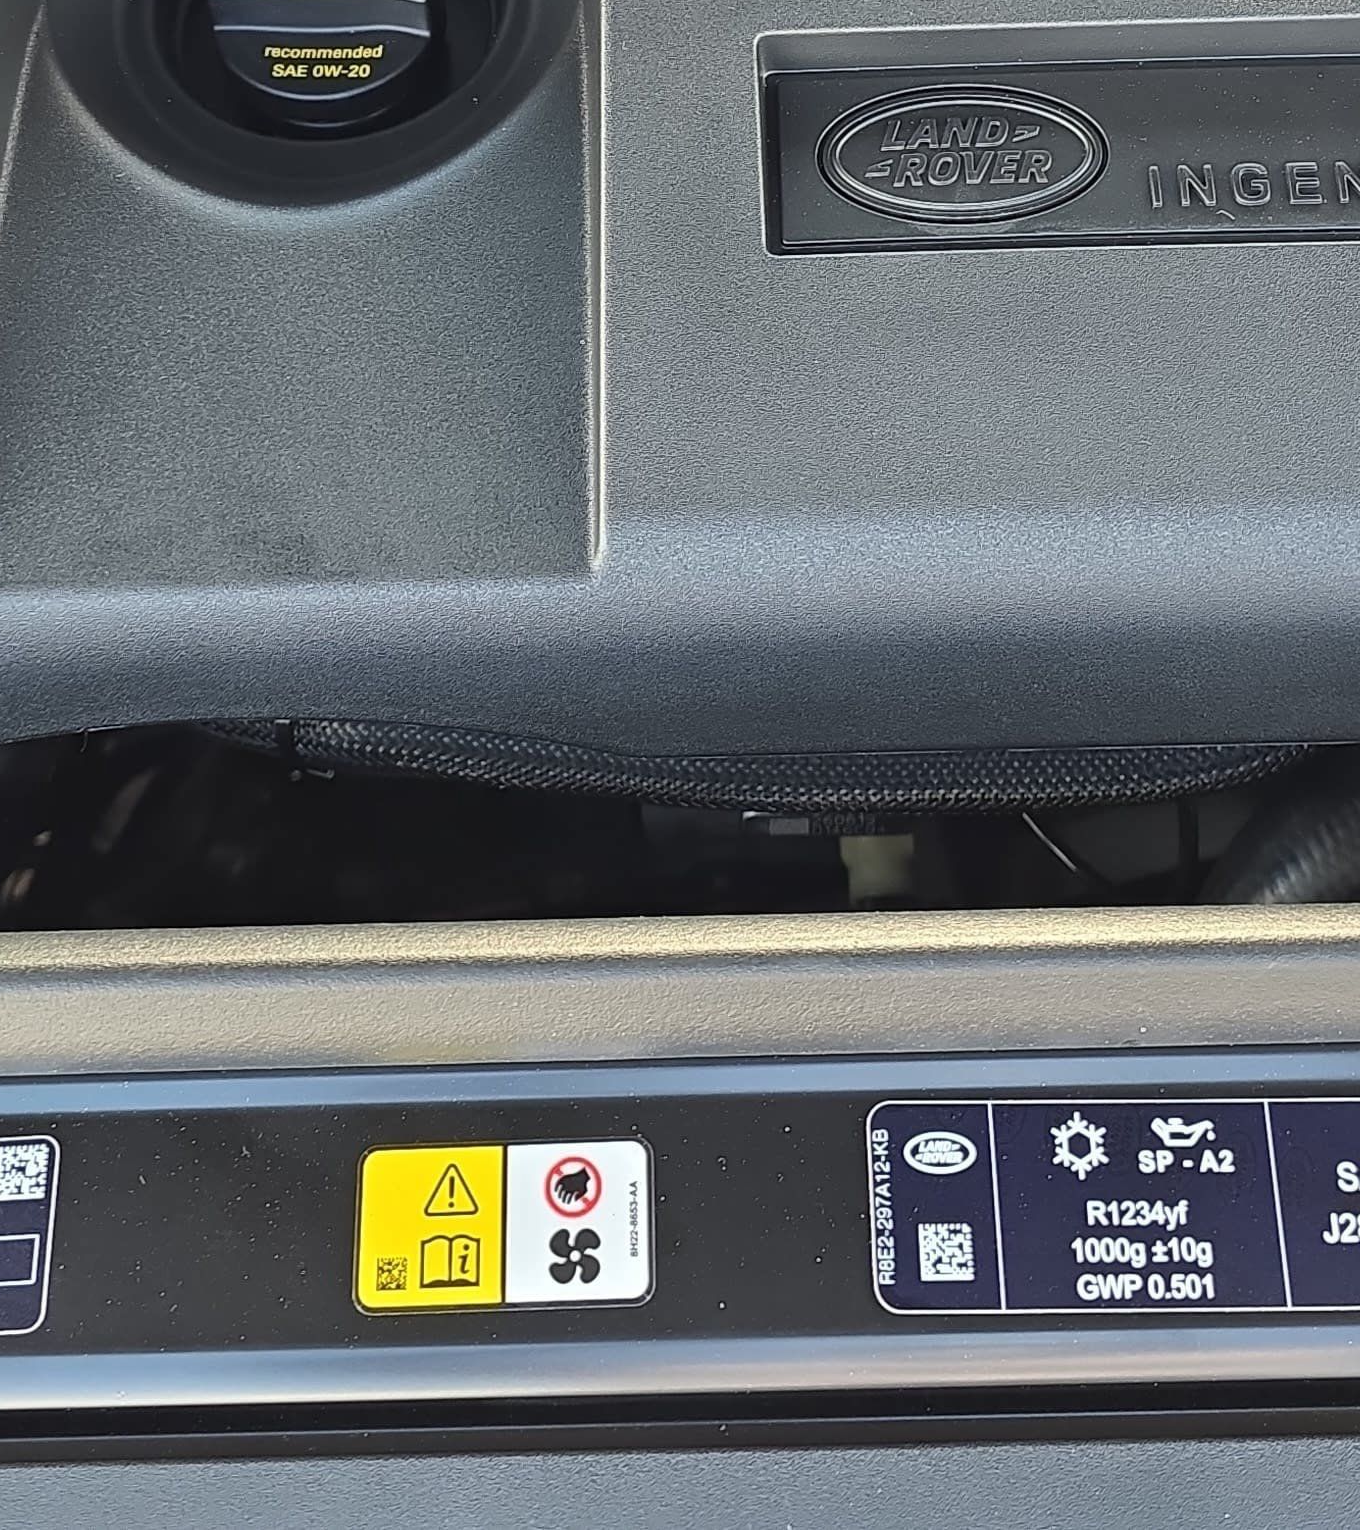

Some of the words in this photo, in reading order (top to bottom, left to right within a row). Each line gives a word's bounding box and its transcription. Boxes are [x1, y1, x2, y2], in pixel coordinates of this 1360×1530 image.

[264, 43, 384, 59] recommended
[271, 64, 308, 78] SAE
[312, 63, 371, 78] 0W-20
[880, 116, 1009, 152] LAND
[892, 149, 1053, 188] ROVER
[918, 1140, 952, 1153] LAND
[923, 1152, 964, 1165] ROVER
[1137, 1149, 1174, 1174] SP
[1199, 1149, 1236, 1174] A2
[871, 1128, 897, 1286] R8E2-297A12-KB
[1086, 1199, 1190, 1231] R1234yf
[1071, 1236, 1146, 1269] 1000g
[1150, 1236, 1214, 1268] ±10g
[1076, 1274, 1143, 1300] GWP
[1147, 1273, 1216, 1300] 0.501
